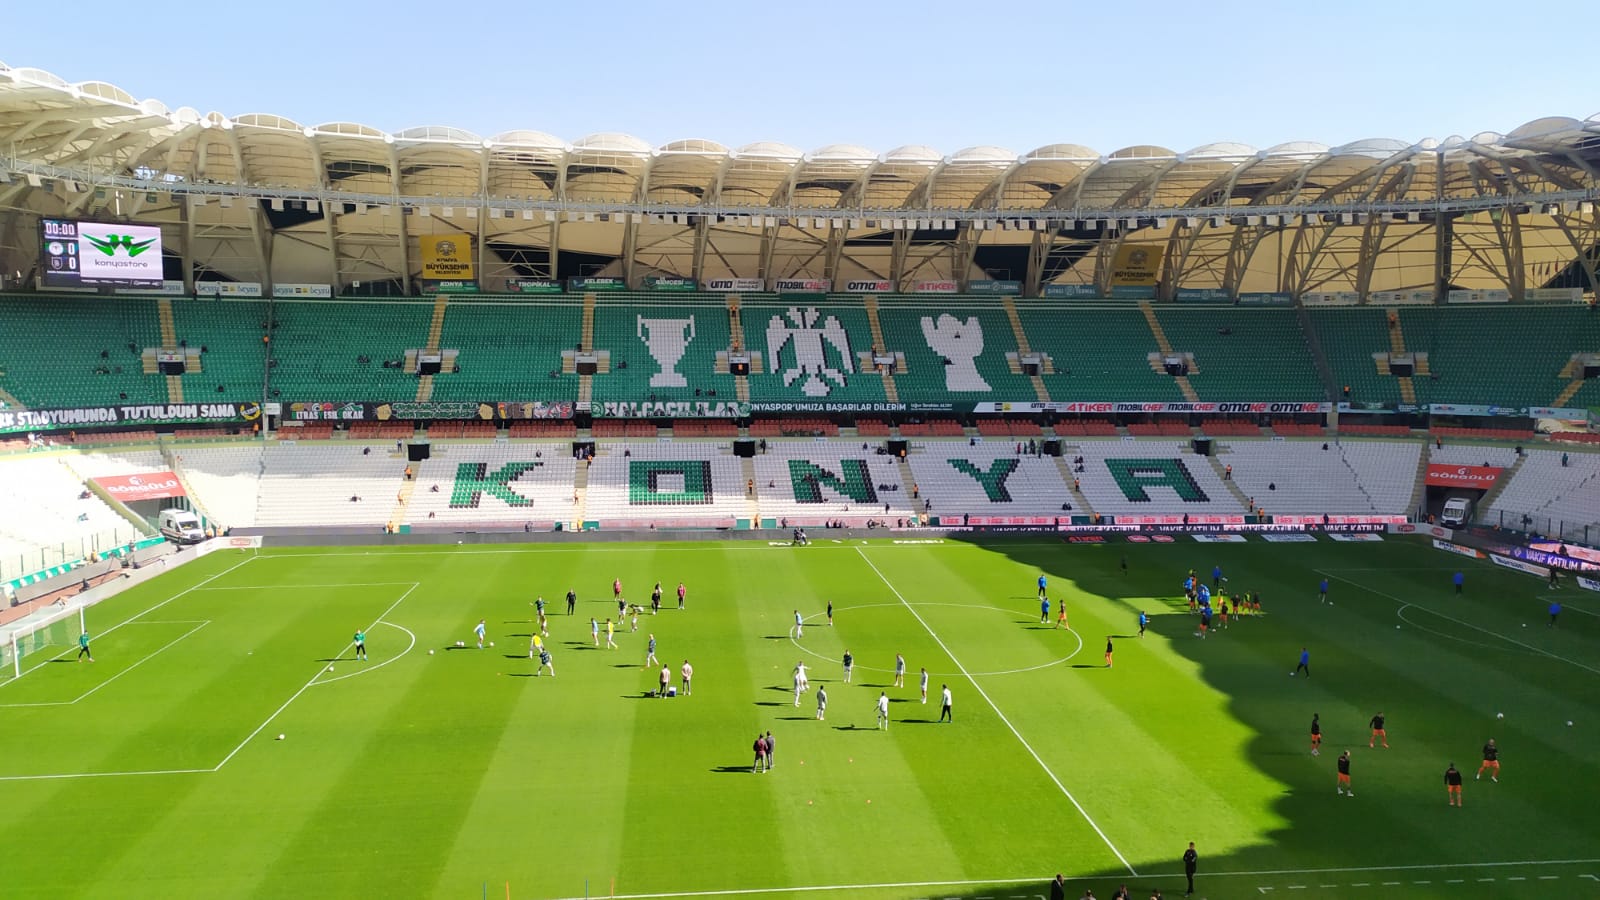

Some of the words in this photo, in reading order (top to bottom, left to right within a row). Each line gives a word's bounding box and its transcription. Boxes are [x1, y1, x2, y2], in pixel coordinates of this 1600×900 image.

[45, 222, 75, 235] 00:00
[68, 242, 75, 255] 0
[69, 256, 76, 269] 0
[94, 259, 148, 268] konyastore
[120, 404, 197, 420] TUTULDUM
[200, 403, 236, 417] SANA
[826, 403, 872, 412] BAŞARILAR
[874, 402, 906, 411] DİLERİM
[449, 457, 1211, 508] KONYA
[1547, 554, 1578, 571] KATILIM
